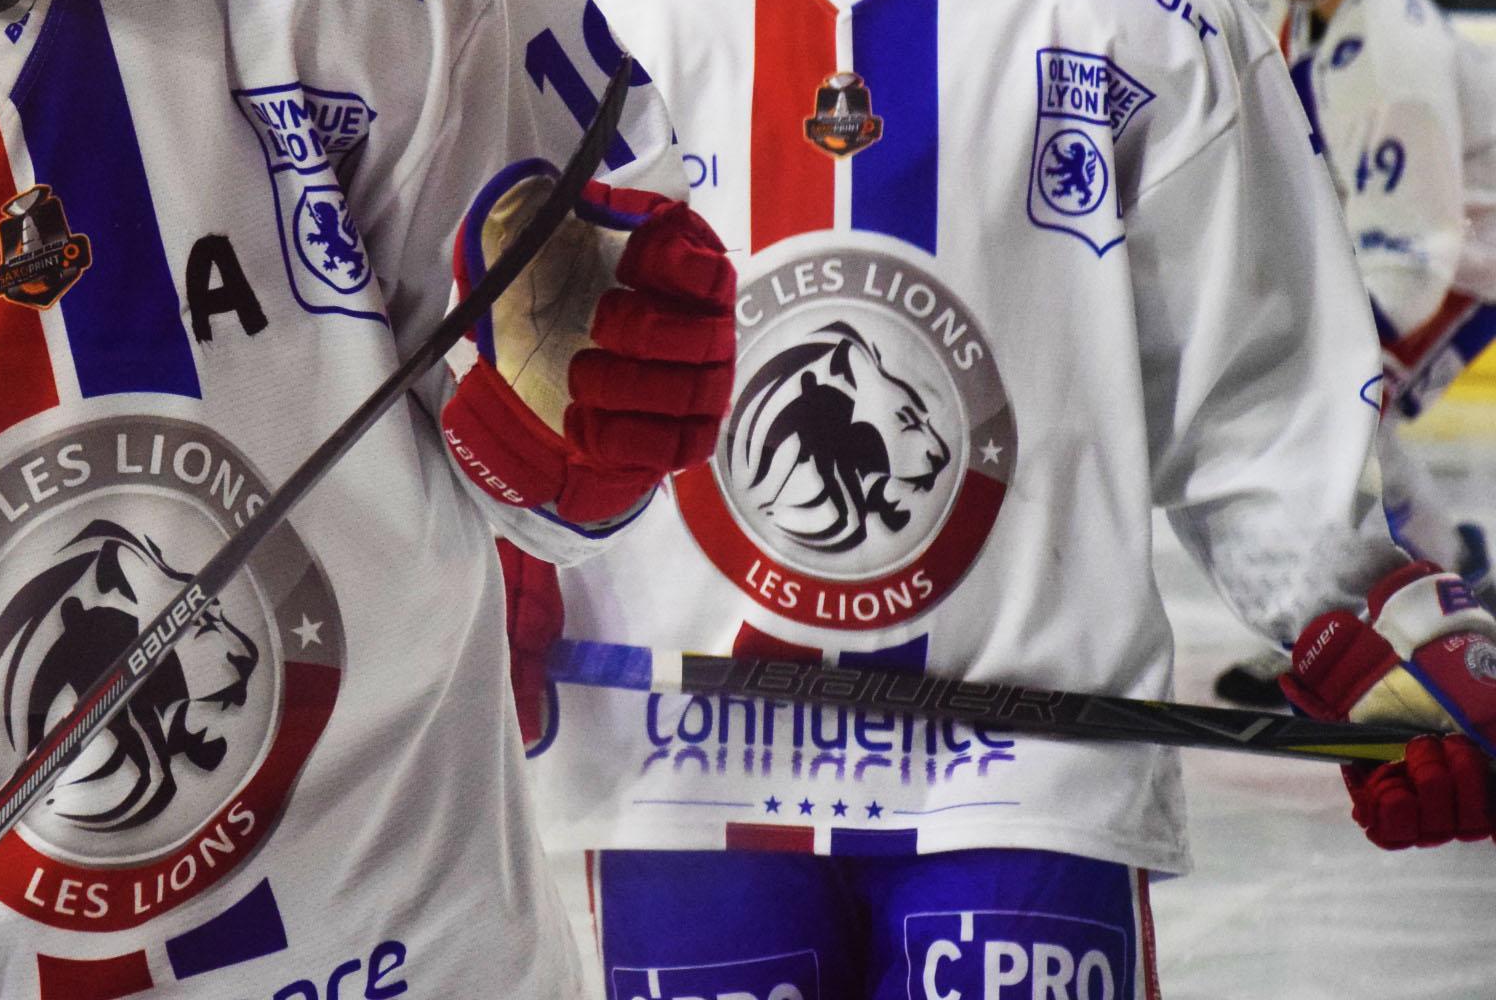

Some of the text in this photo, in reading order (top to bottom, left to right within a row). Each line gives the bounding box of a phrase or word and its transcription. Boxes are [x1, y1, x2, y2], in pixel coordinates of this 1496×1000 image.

[185, 232, 269, 345] A
[771, 258, 845, 306] LES
[863, 262, 984, 371] LIONS
[745, 559, 934, 621] LES LIONS
[23, 801, 255, 919] LES LIONS
